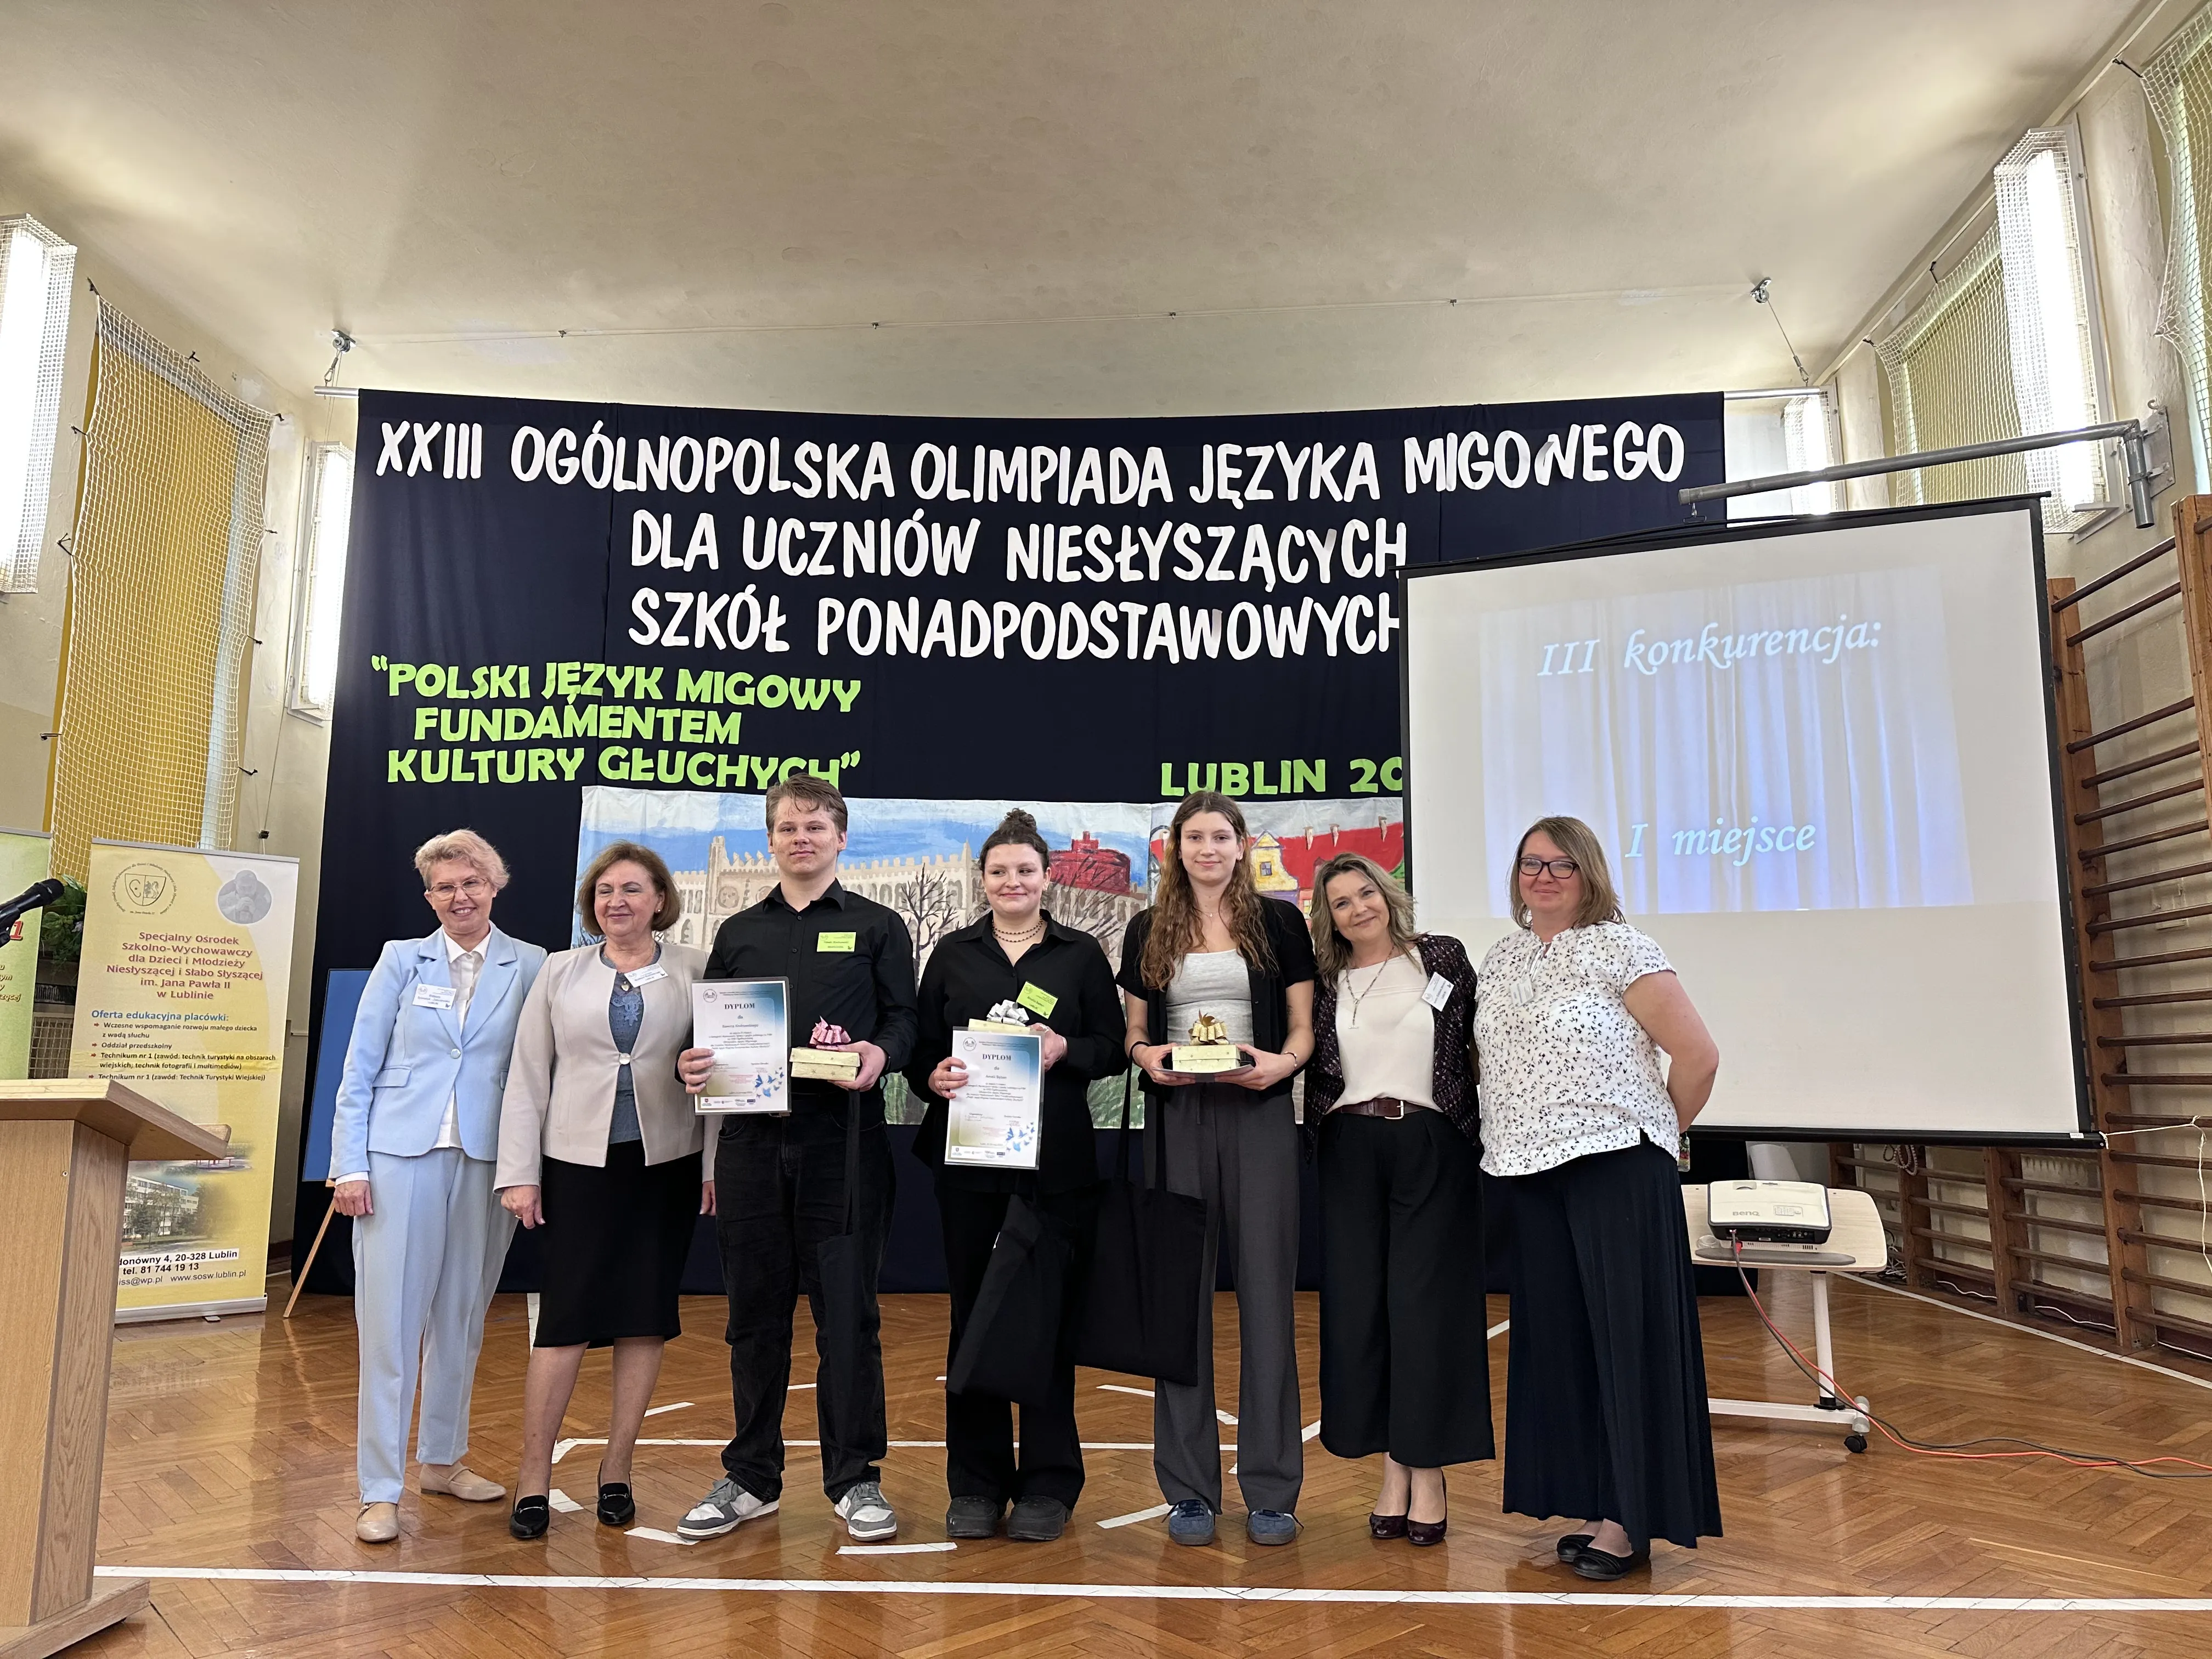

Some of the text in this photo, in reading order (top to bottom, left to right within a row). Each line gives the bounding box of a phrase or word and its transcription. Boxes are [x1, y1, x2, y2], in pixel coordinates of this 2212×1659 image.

[376, 420, 1684, 510] XXIII OGÓLNOPOLSKA OLIMPIADA JĘZYKA MIGOWEGO
[631, 508, 1407, 592] DLA UCZNIÓW NIESŁYSZĄCYCH
[628, 584, 1400, 664] SZKÓŁ PONADPODSTAWOWYCH
[1537, 614, 1882, 676] III konkurencja:
[541, 661, 664, 705] JĘZYK
[675, 668, 861, 712] MIGOWY
[414, 704, 742, 744] FUNDAMENTEM
[387, 747, 584, 784] KULTURY
[1161, 759, 1326, 797] LUBLIN
[1625, 816, 1816, 867] I miejsce
[139, 932, 239, 945] Specjalny Ośrodek
[121, 942, 253, 957] Szkolno-Wychowawczy
[128, 954, 245, 969] dla Dzieci i Młodzieży
[106, 964, 263, 980] Niesłyszącej i Słabo Słyszącej
[140, 977, 158, 986] im.
[160, 979, 185, 988] Jana
[188, 980, 221, 989] Pawła
[171, 991, 214, 1000] Lublinie
[92, 1010, 229, 1022] Oferta edukacyjna placówki:
[163, 1255, 172, 1263] 4,
[175, 1251, 206, 1262] 20-328
[209, 1250, 238, 1260] Lublin
[123, 1262, 199, 1275] tel. 81 744 19 13
[170, 1269, 247, 1283] www.sosw.lublin.pl
